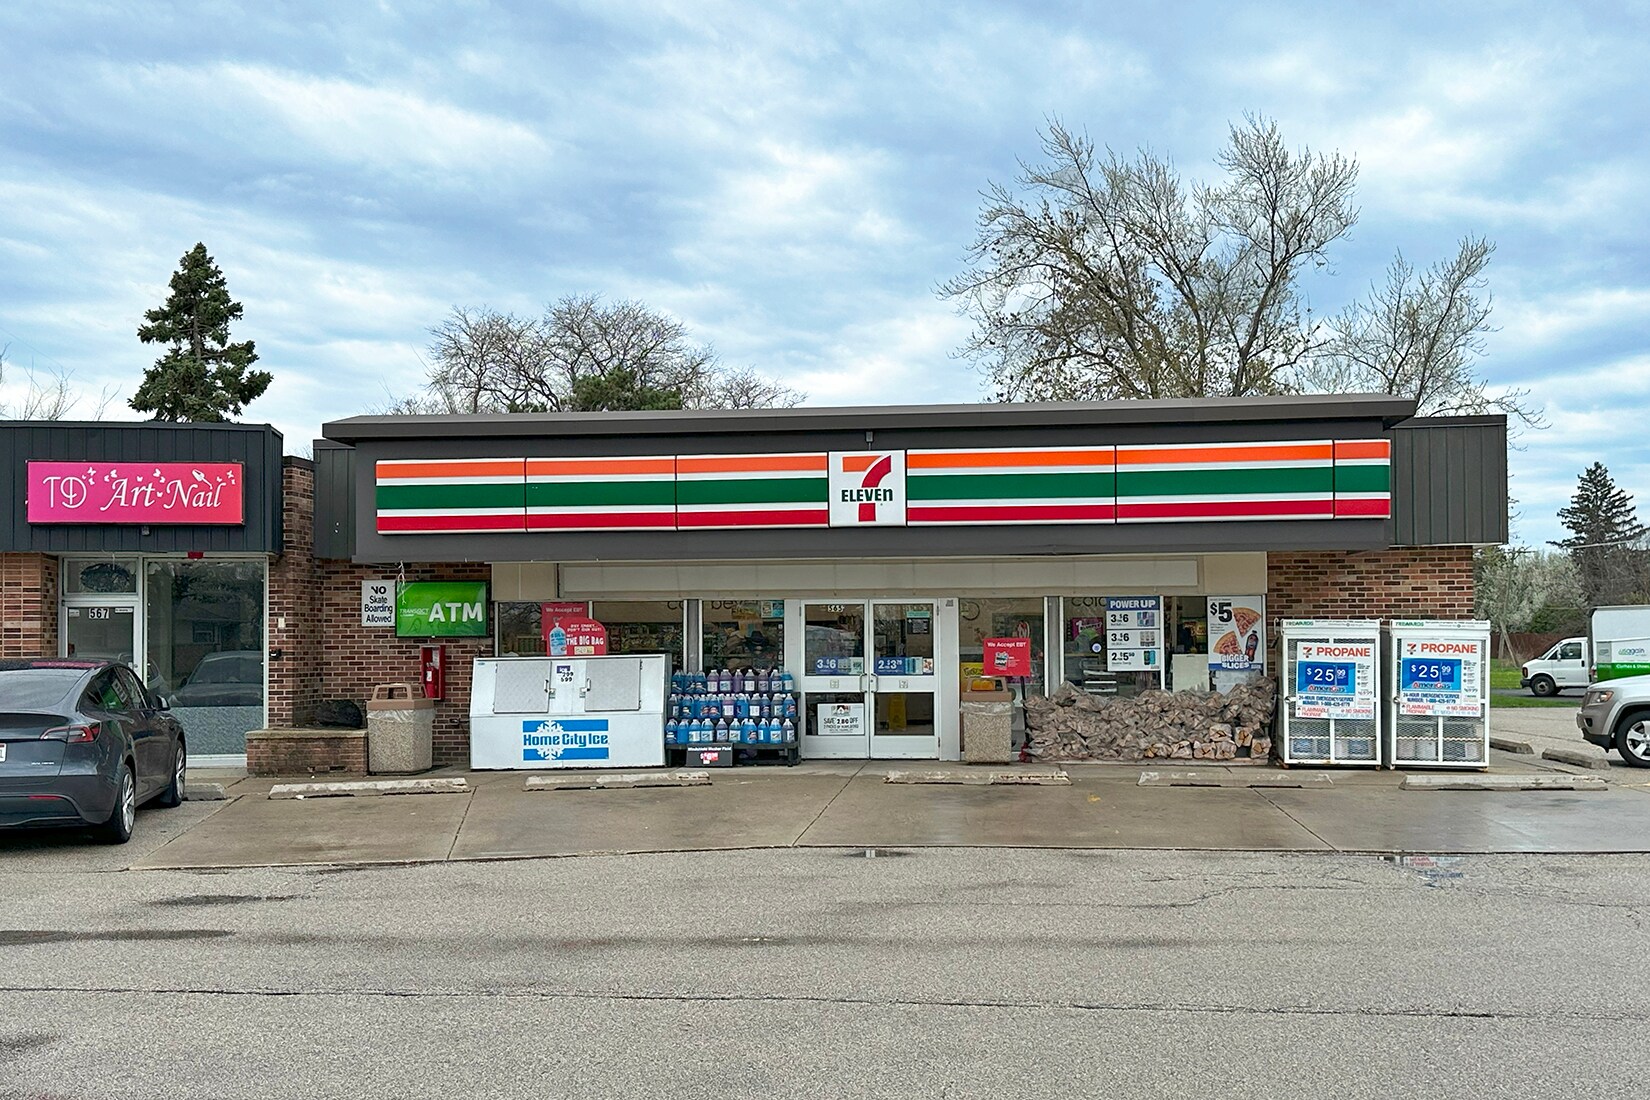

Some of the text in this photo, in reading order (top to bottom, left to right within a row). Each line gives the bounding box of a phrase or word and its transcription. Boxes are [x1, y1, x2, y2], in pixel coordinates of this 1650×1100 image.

[842, 455, 892, 522] 7
[100, 478, 155, 511] Art
[163, 479, 226, 509] Nail
[369, 595, 388, 604] Skate
[1110, 599, 1156, 609] POWER UP
[90, 608, 108, 618] 567
[364, 604, 393, 614] Boarding
[428, 602, 483, 622] ATM
[1210, 602, 1233, 623] $5
[366, 614, 392, 623] Allowed
[1110, 614, 1117, 622] 3
[566, 636, 604, 645] THE BIG BAG
[1111, 633, 1117, 642] 3
[1316, 647, 1371, 657] PROPANE
[1421, 643, 1477, 653] PROPANE
[1111, 652, 1117, 660] 2
[1221, 654, 1249, 662] BIGGER
[816, 659, 823, 668] 3
[878, 660, 884, 669] 2
[523, 733, 609, 748] Home City Ice
